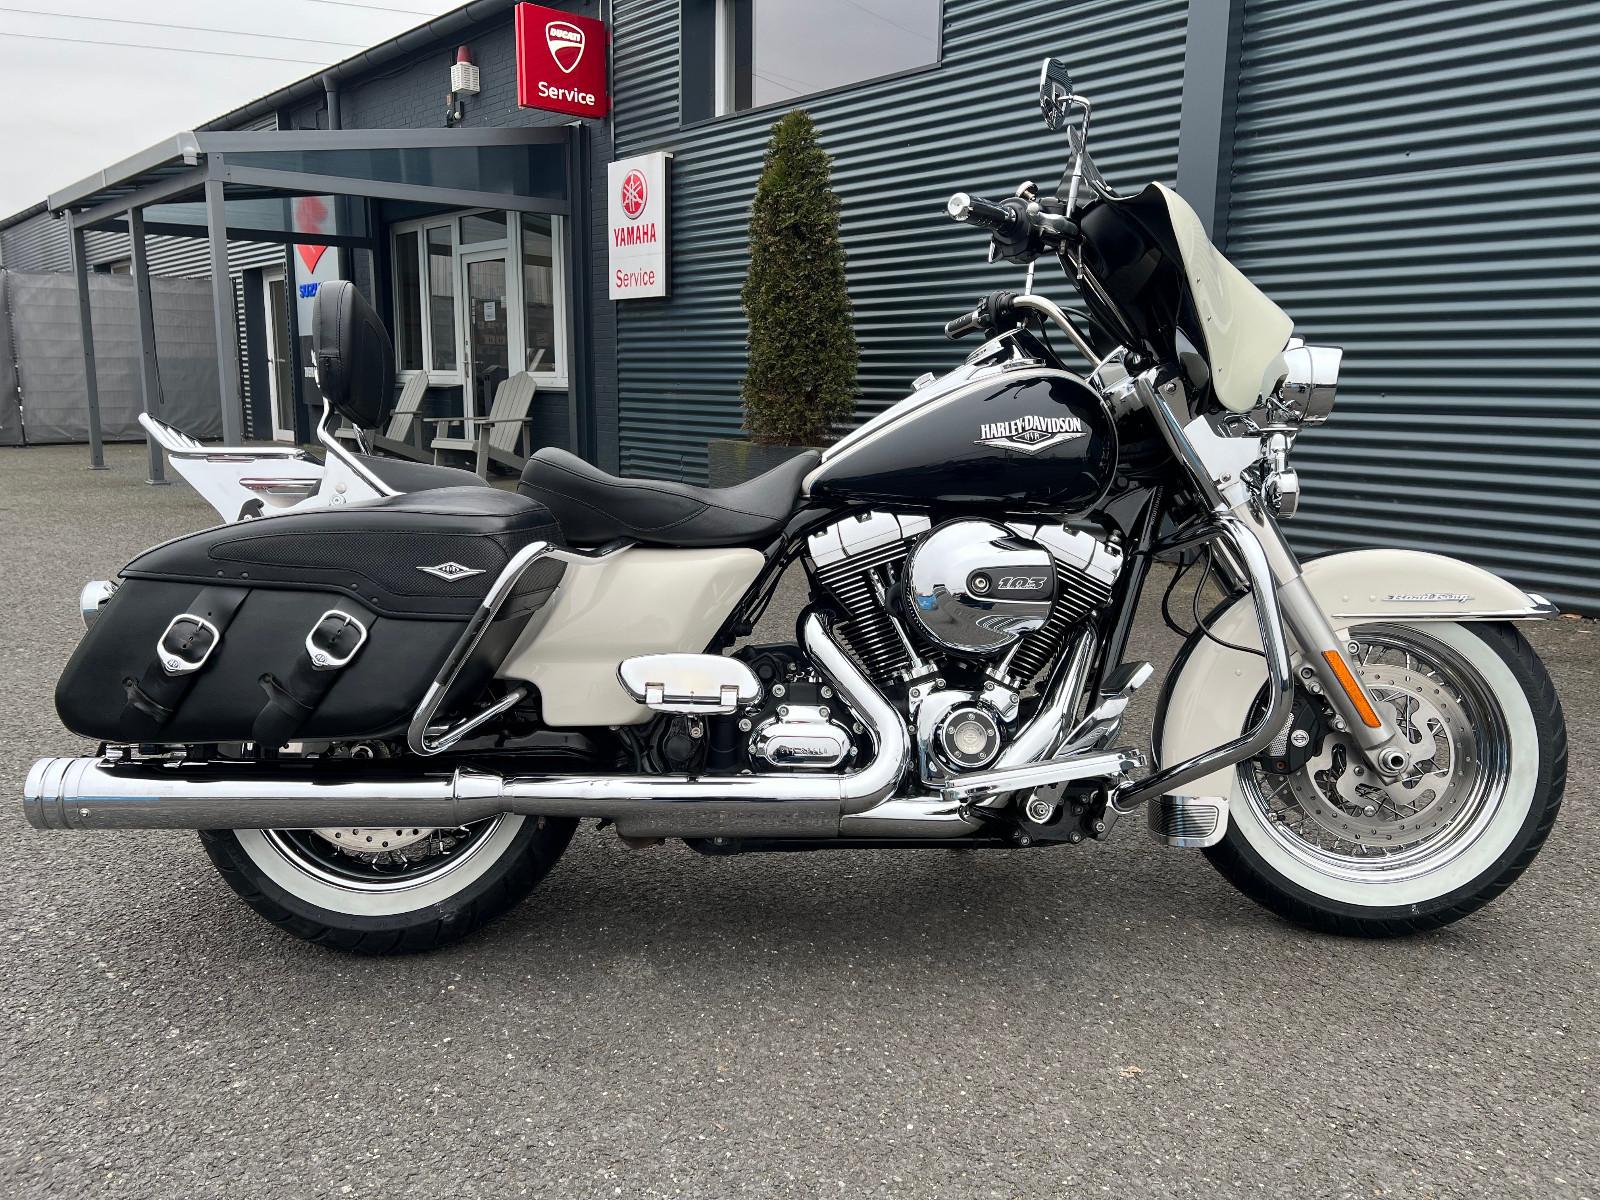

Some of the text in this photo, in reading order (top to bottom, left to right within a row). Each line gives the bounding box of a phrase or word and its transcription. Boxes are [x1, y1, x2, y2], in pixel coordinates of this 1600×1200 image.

[549, 27, 581, 42] DUCATI
[538, 81, 596, 106] Service
[614, 222, 657, 248] YAMAHA
[616, 267, 656, 289] Service
[997, 576, 1047, 590] 103
